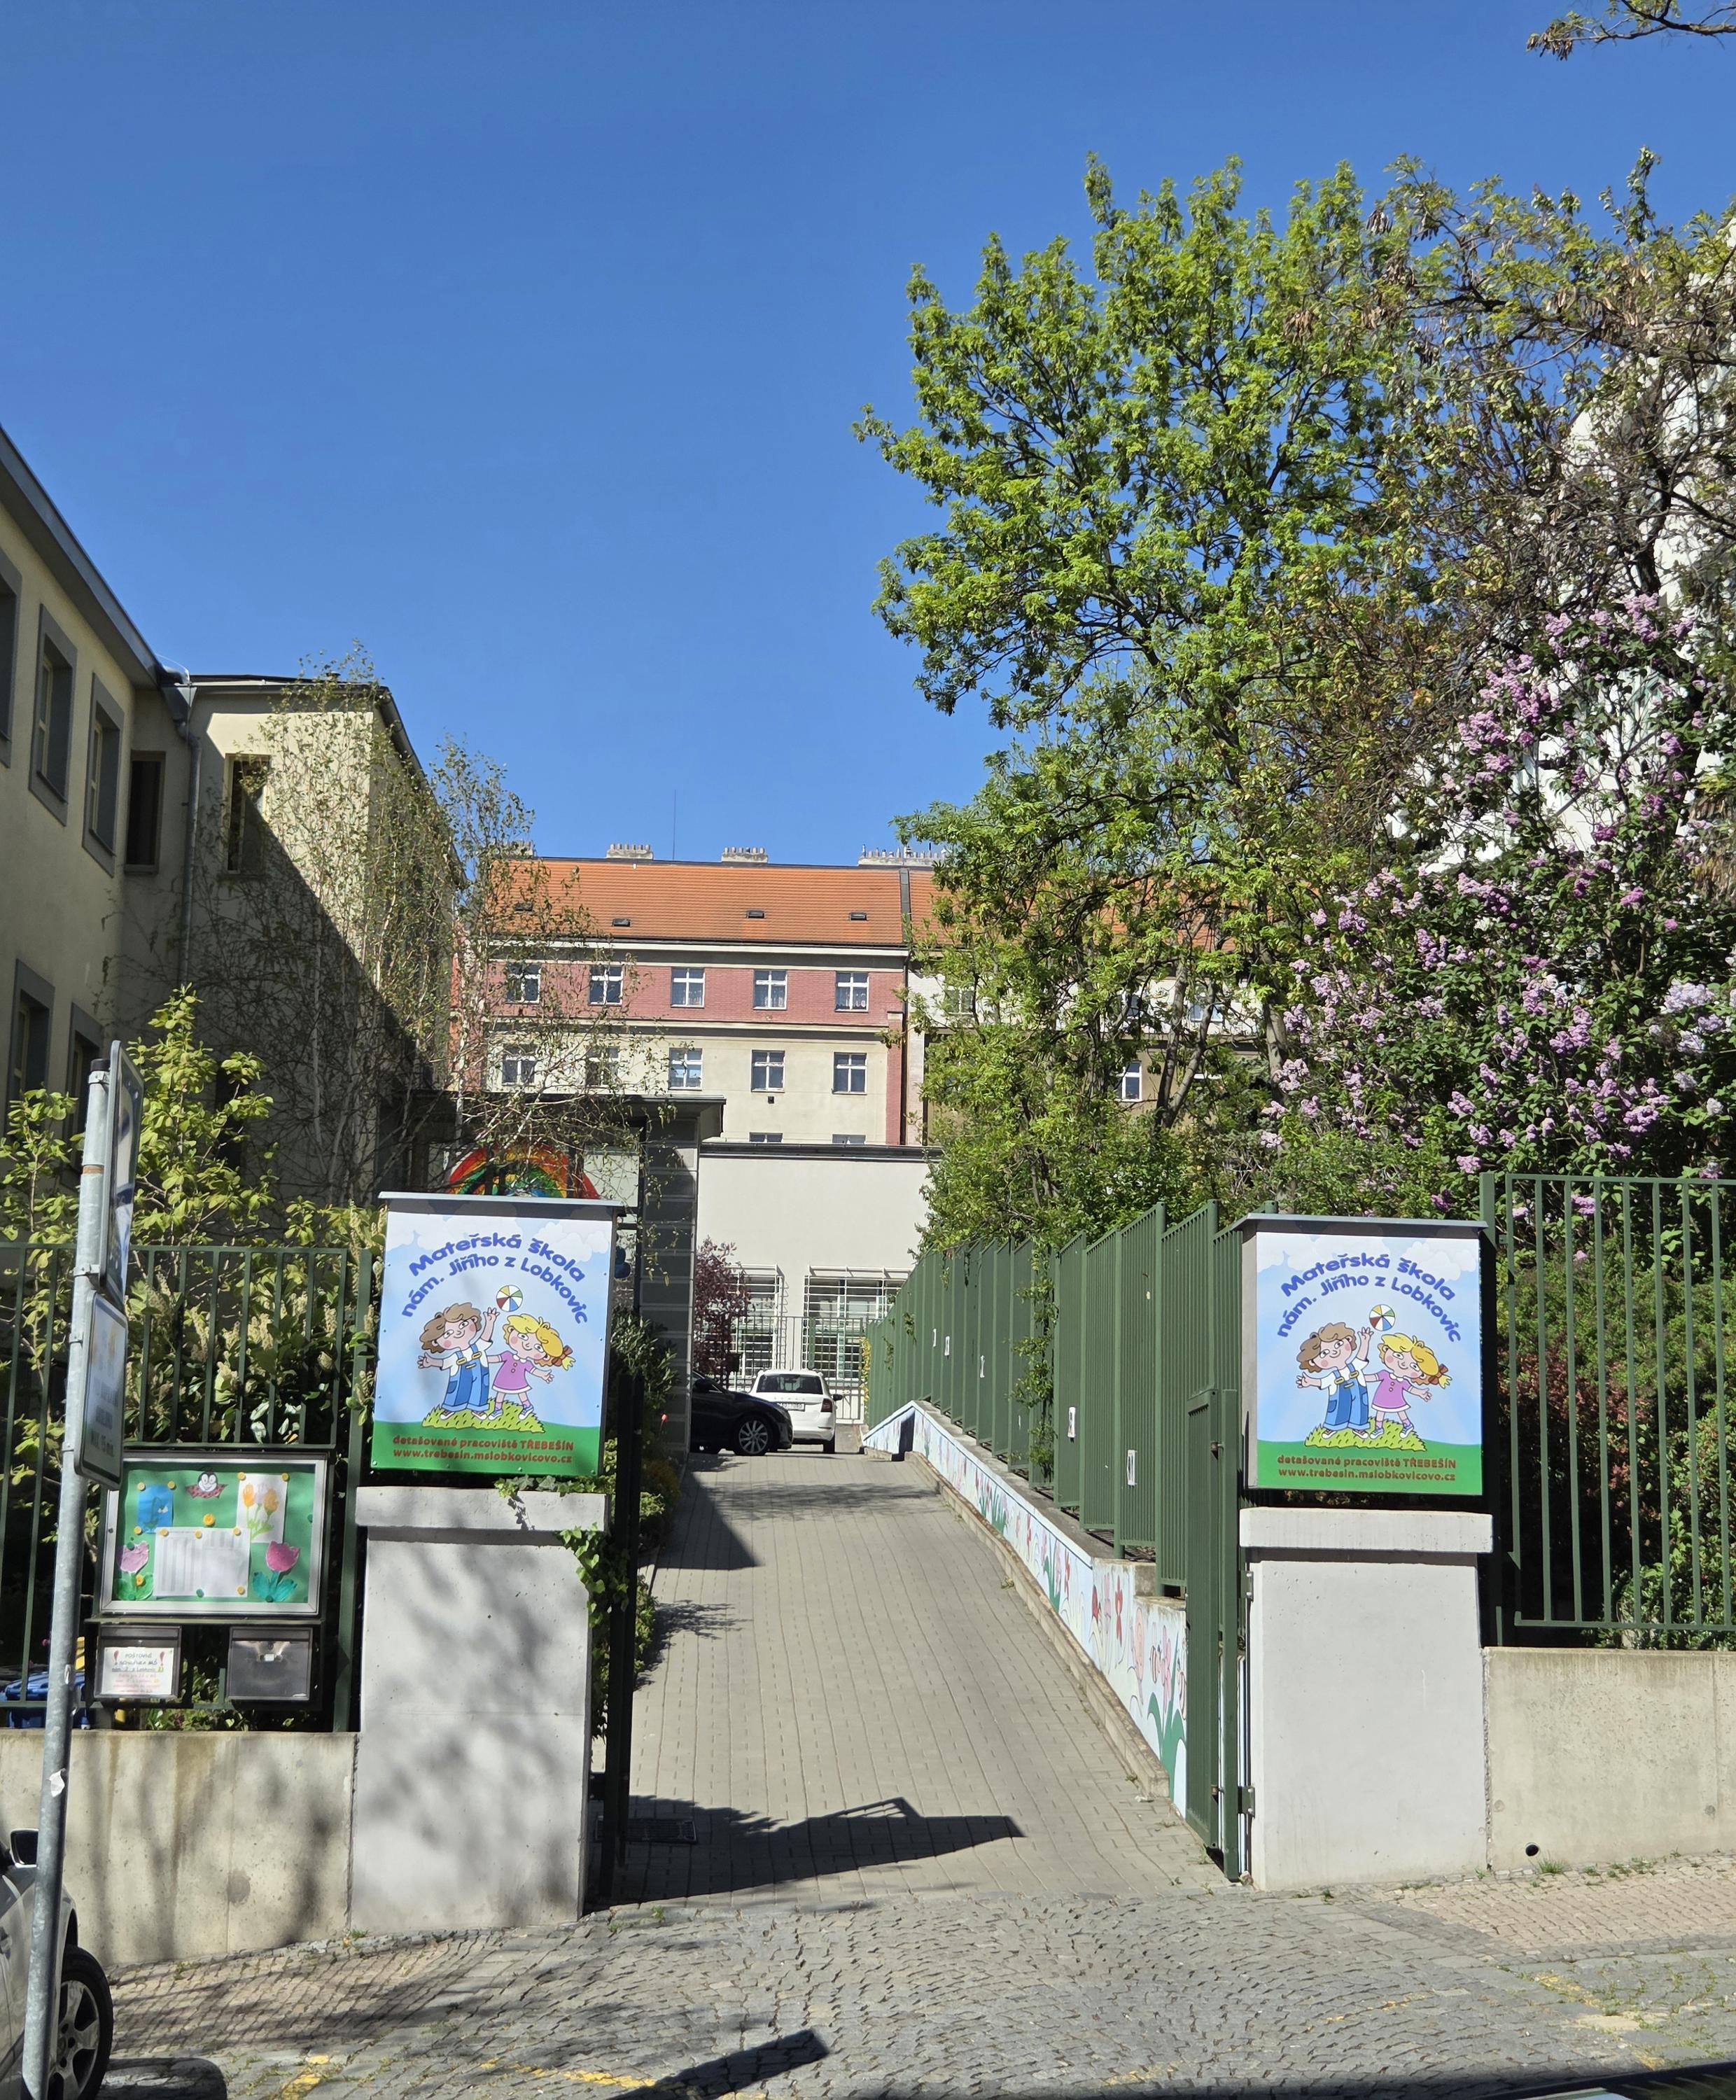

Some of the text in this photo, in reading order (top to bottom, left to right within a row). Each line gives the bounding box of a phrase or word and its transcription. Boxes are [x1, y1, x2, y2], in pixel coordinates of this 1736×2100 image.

[409, 1232, 585, 1282] Mateřská škola
[402, 1253, 587, 1324] nám. Jiřího z Lobkovic
[1280, 1252, 1456, 1301] Mateřská škola
[1277, 1273, 1462, 1342] nám. Jiřího z Lobkovic
[393, 1435, 574, 1451] detašované pracoviště TŘEBEŠÍN
[393, 1449, 573, 1463] www.trebesin.mslobkovicovo.cz
[1277, 1455, 1456, 1469] detašované pracoviště TŘEBEŠÍN
[1278, 1468, 1456, 1481] www.trebesin.mslobkovicovo.cz
